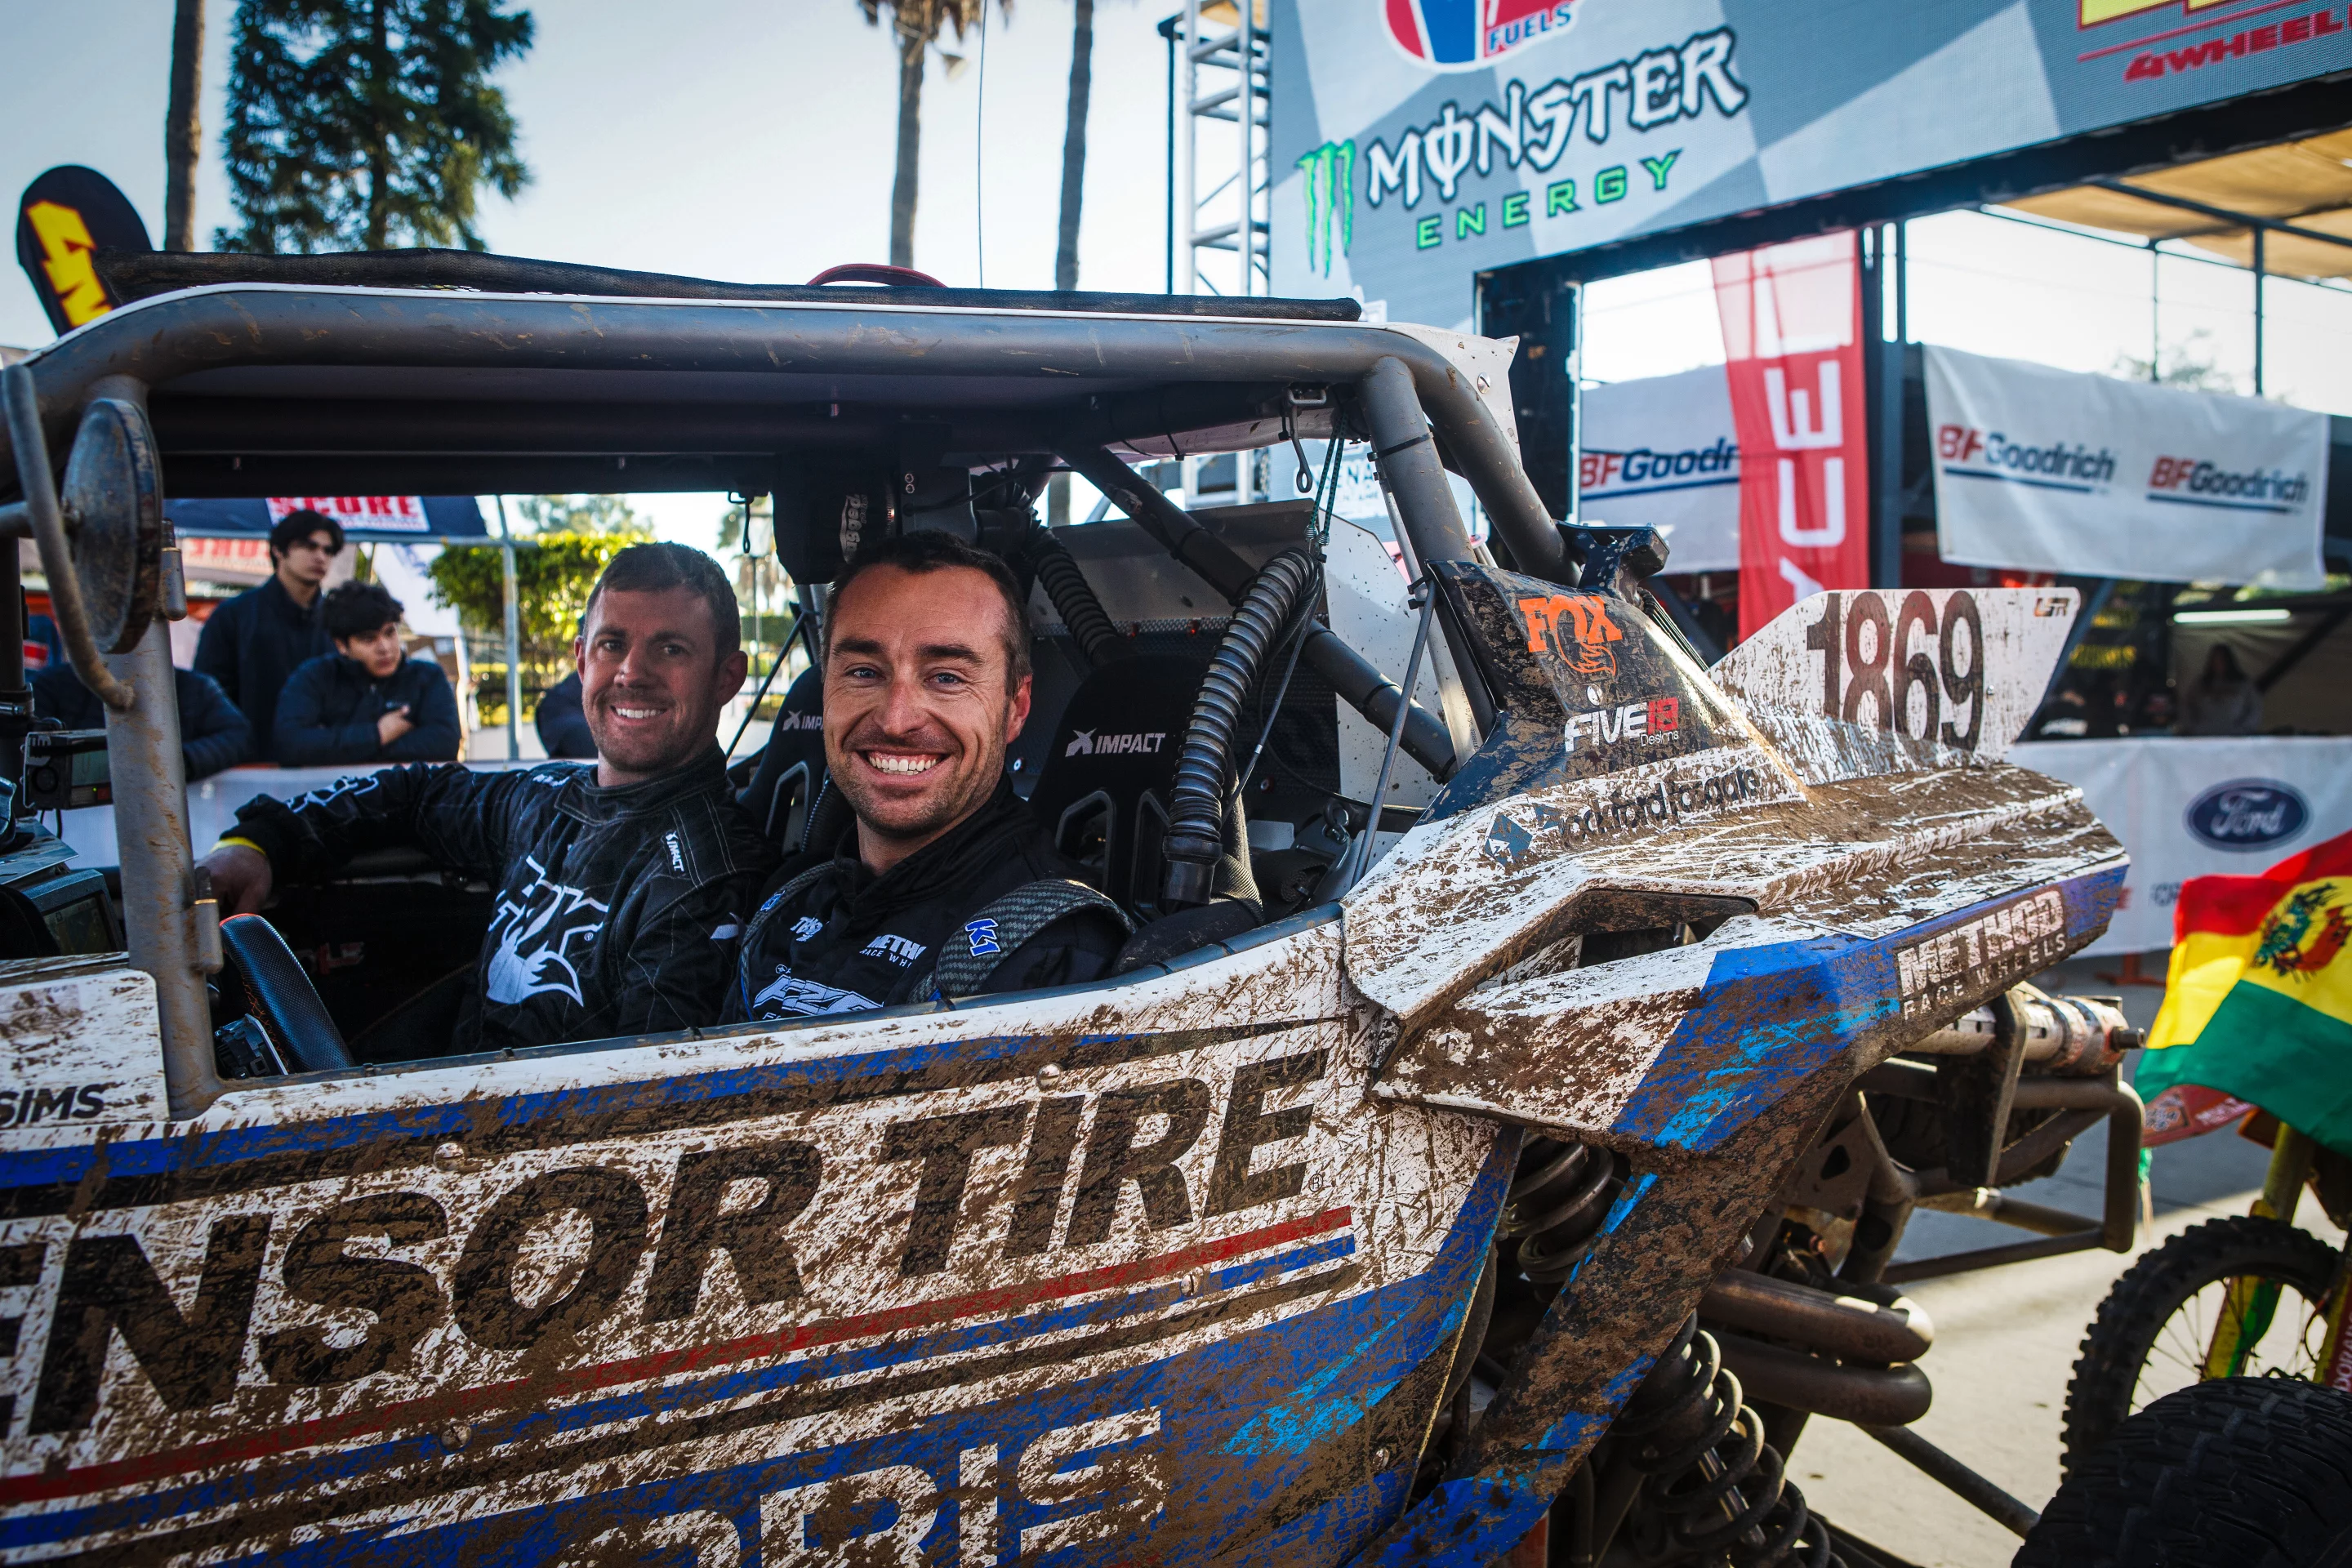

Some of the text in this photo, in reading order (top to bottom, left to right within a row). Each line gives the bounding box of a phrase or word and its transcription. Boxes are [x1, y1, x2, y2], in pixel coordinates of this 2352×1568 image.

[1487, 2, 1572, 53] FUELS
[1366, 24, 1750, 209] MONSTER
[1417, 149, 1684, 250] ENERGY
[1937, 422, 2117, 483] BFGoodrich
[2147, 454, 2310, 506] BFGoodrich
[1517, 594, 1624, 658] FOX
[1806, 590, 1984, 751] 1869
[1095, 732, 1166, 755] IMPACT
[2209, 788, 2288, 838] Ford
[866, 933, 928, 961] METH
[1896, 889, 2065, 997] METHOD
[878, 1046, 1330, 1279] TIRE
